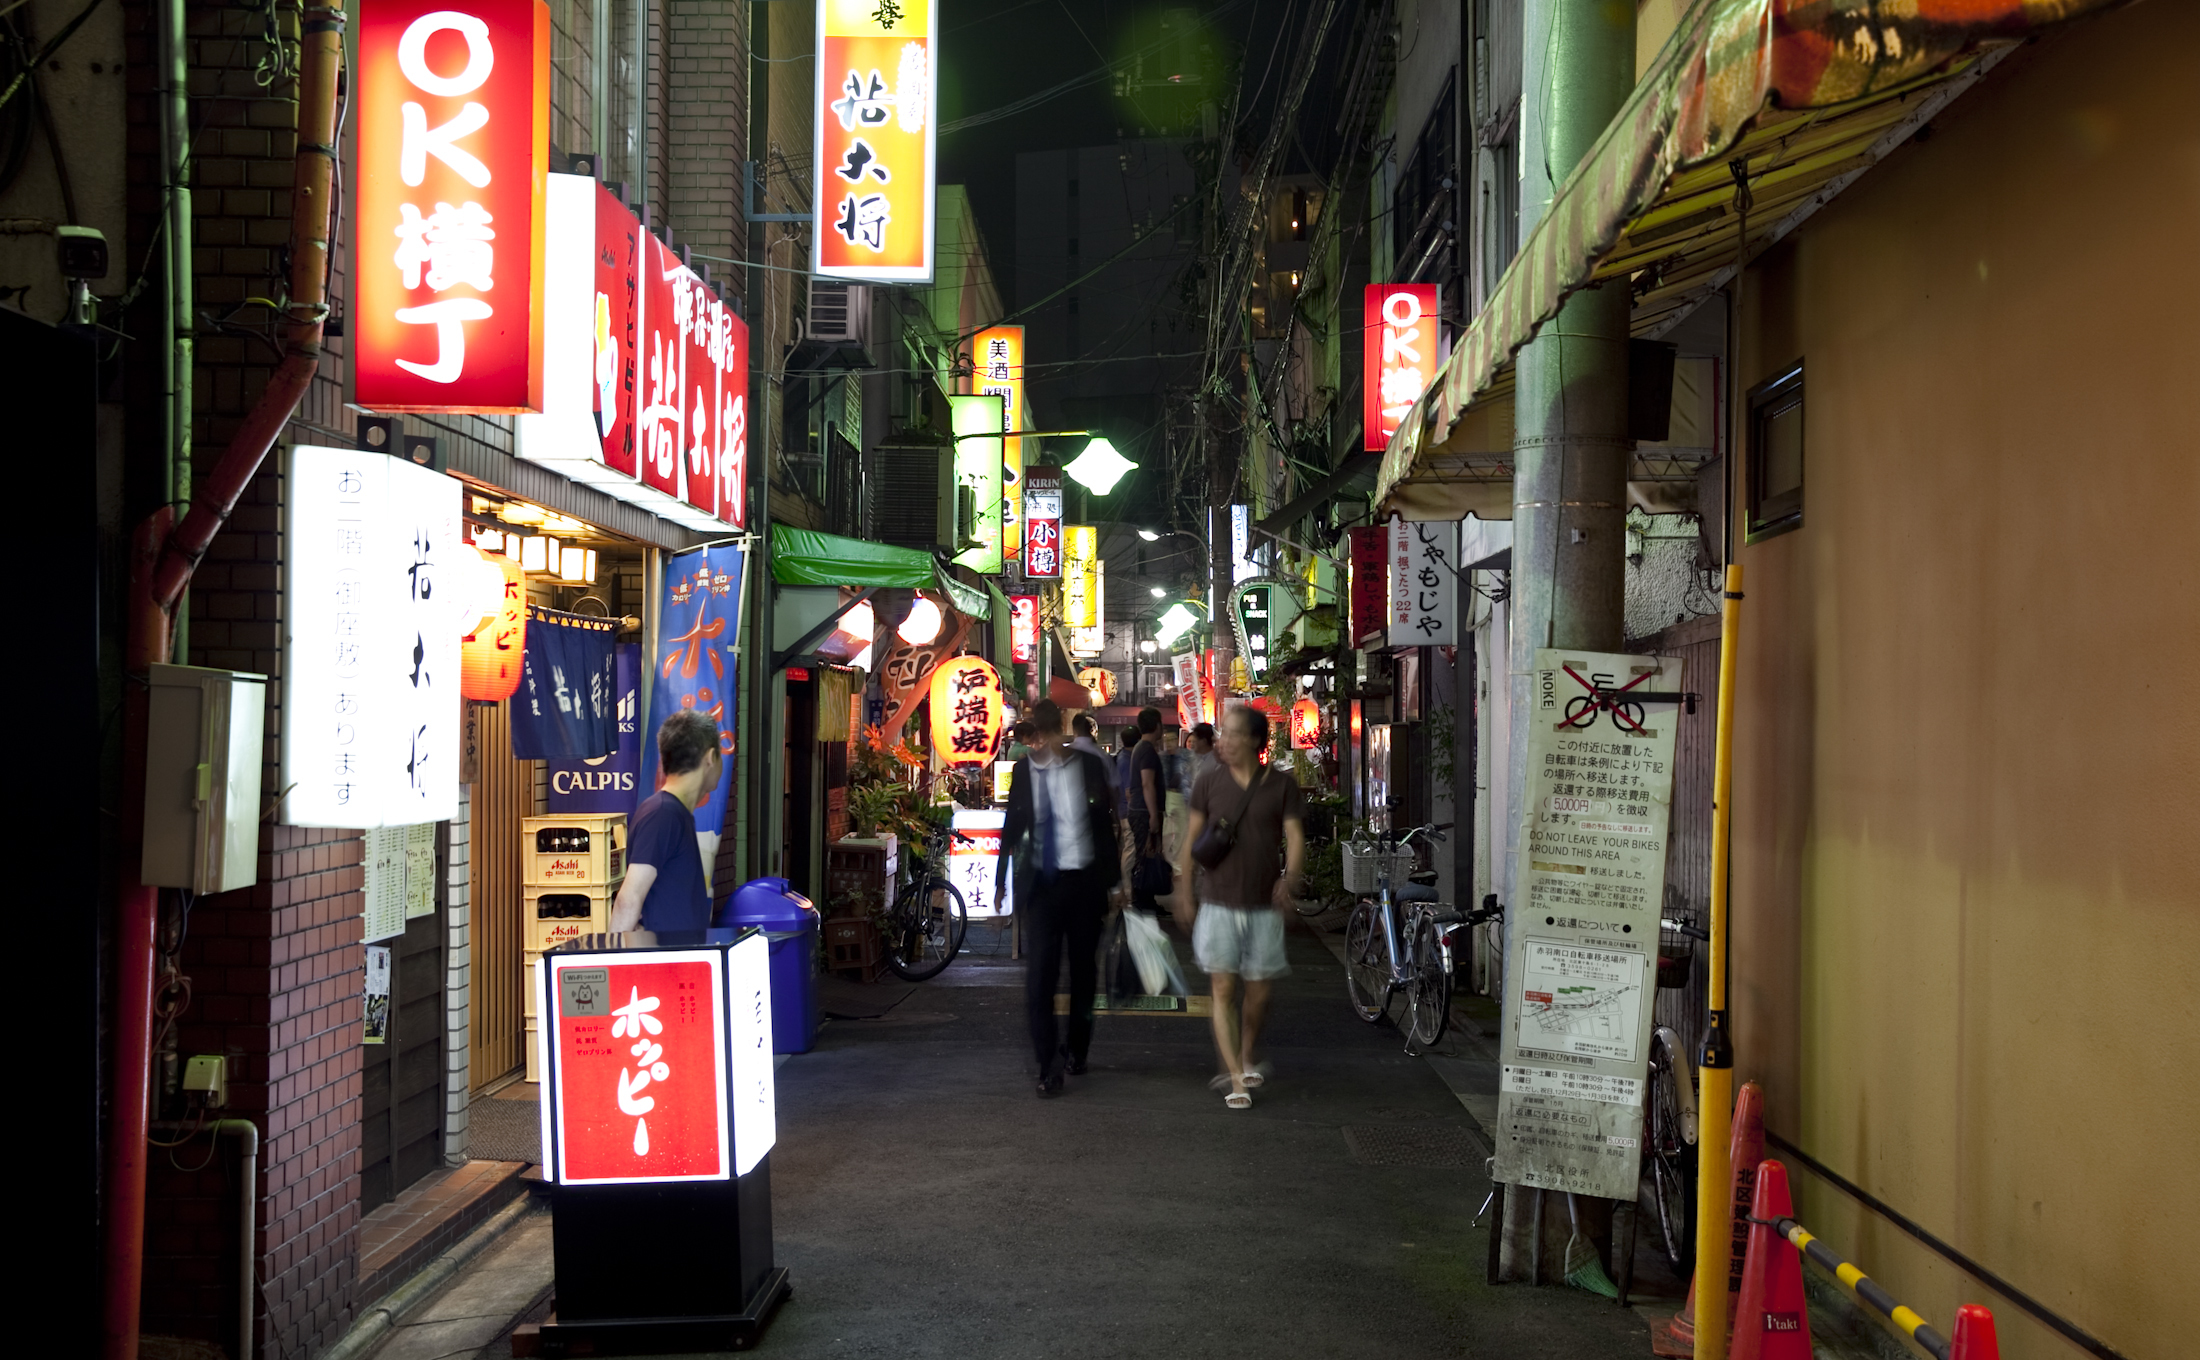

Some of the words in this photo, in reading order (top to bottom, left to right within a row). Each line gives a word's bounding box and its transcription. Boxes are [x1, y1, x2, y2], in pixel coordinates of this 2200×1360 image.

[623, 231, 637, 458] アサヒビール
[1029, 478, 1060, 488] KIRIN
[1031, 522, 1056, 573] 小樽
[671, 593, 692, 602] カロリー
[1245, 610, 1268, 619] SNACK
[495, 579, 518, 679] ホッピー
[1542, 671, 1555, 708] NOKE
[951, 668, 990, 754] 炉端焼
[1557, 740, 1653, 758] この付近に放置した
[1545, 753, 1664, 774] 自転車は条例により下記
[552, 770, 635, 795] CALPIS
[1543, 768, 1645, 788] の場所へ移送します。
[1552, 783, 1650, 802] 返還する際移送費用
[1540, 812, 1576, 825] します。
[1529, 831, 1543, 840] DO
[1545, 832, 1566, 842] NOT
[1568, 834, 1598, 845] LEAVE
[1603, 837, 1629, 848] YOUR
[1631, 840, 1660, 851] BIKES
[1528, 844, 1569, 856] AROUND
[1571, 847, 1593, 859] THIS
[1595, 850, 1620, 861] AREA
[551, 858, 579, 870] Asahi
[1590, 866, 1647, 880] 移送しました。
[576, 870, 585, 879] 20
[965, 861, 988, 909] 弥生
[551, 925, 579, 936] Asahi
[611, 985, 670, 1157] ホッピー
